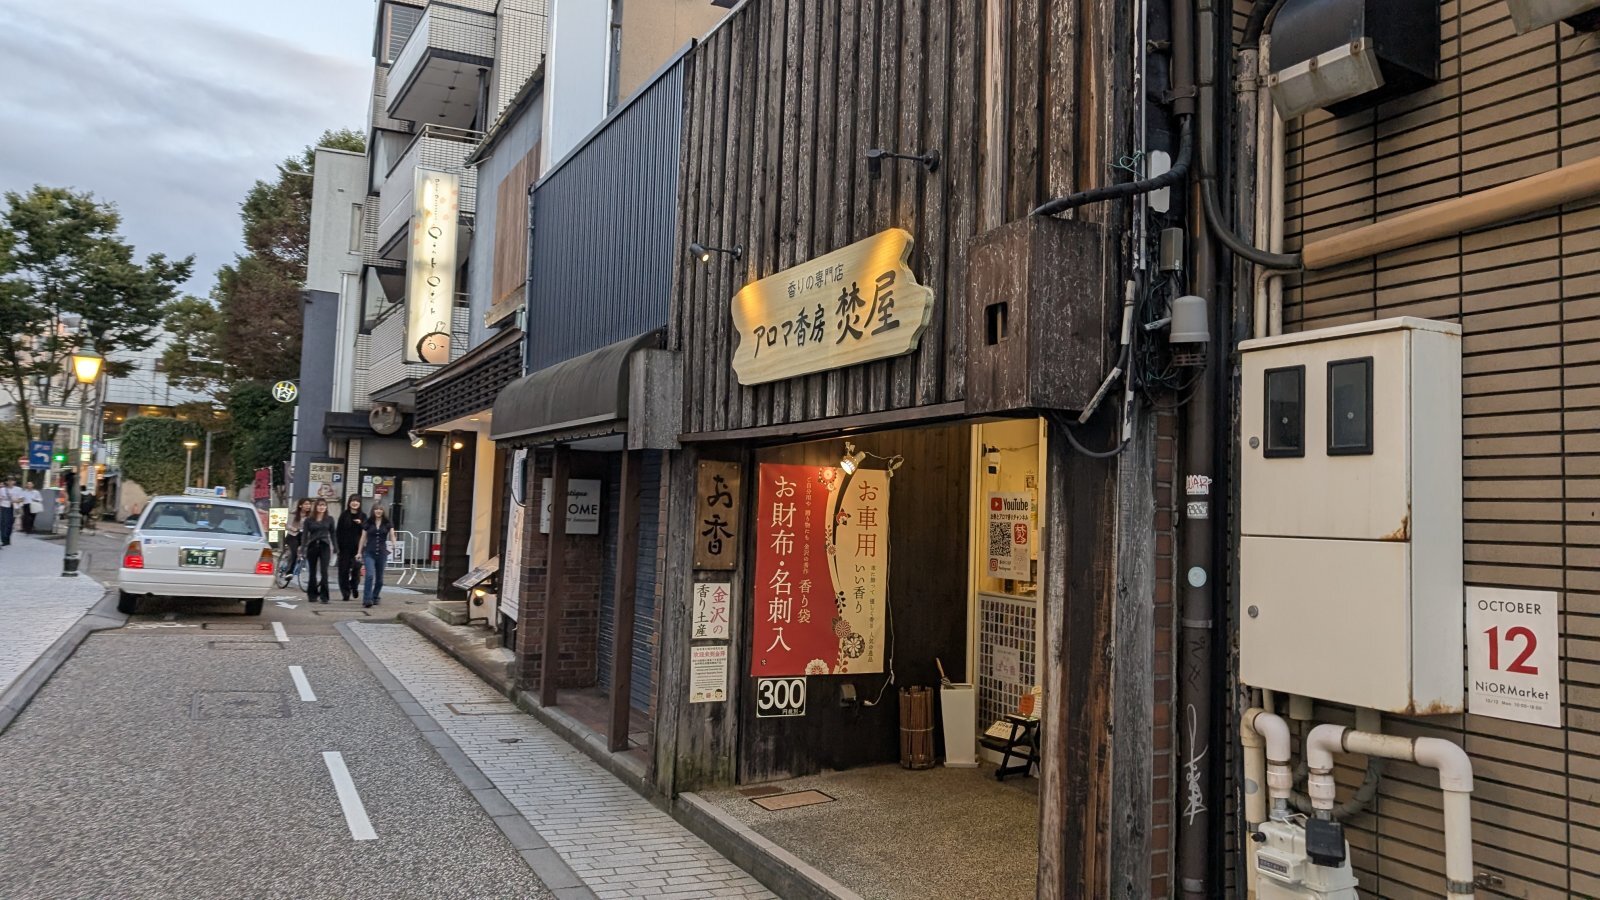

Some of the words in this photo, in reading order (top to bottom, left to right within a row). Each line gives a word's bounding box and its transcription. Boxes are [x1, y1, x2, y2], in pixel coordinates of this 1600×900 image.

[786, 263, 845, 298] 香りの専門店
[753, 303, 827, 359] アロマ香房
[835, 269, 900, 345] 焚屋
[333, 474, 341, 482] P
[701, 474, 735, 556] お香
[854, 480, 879, 558] お車用
[1003, 498, 1028, 511] YouTube
[766, 475, 797, 653] お財布・名刺入
[853, 563, 866, 614] いい香り
[693, 584, 710, 638] 香り土産
[709, 585, 729, 634] 金沢の
[797, 578, 812, 625] 香り袋
[1477, 599, 1542, 615] OCTOBER
[1483, 625, 1539, 676] 12
[758, 679, 805, 710] 300
